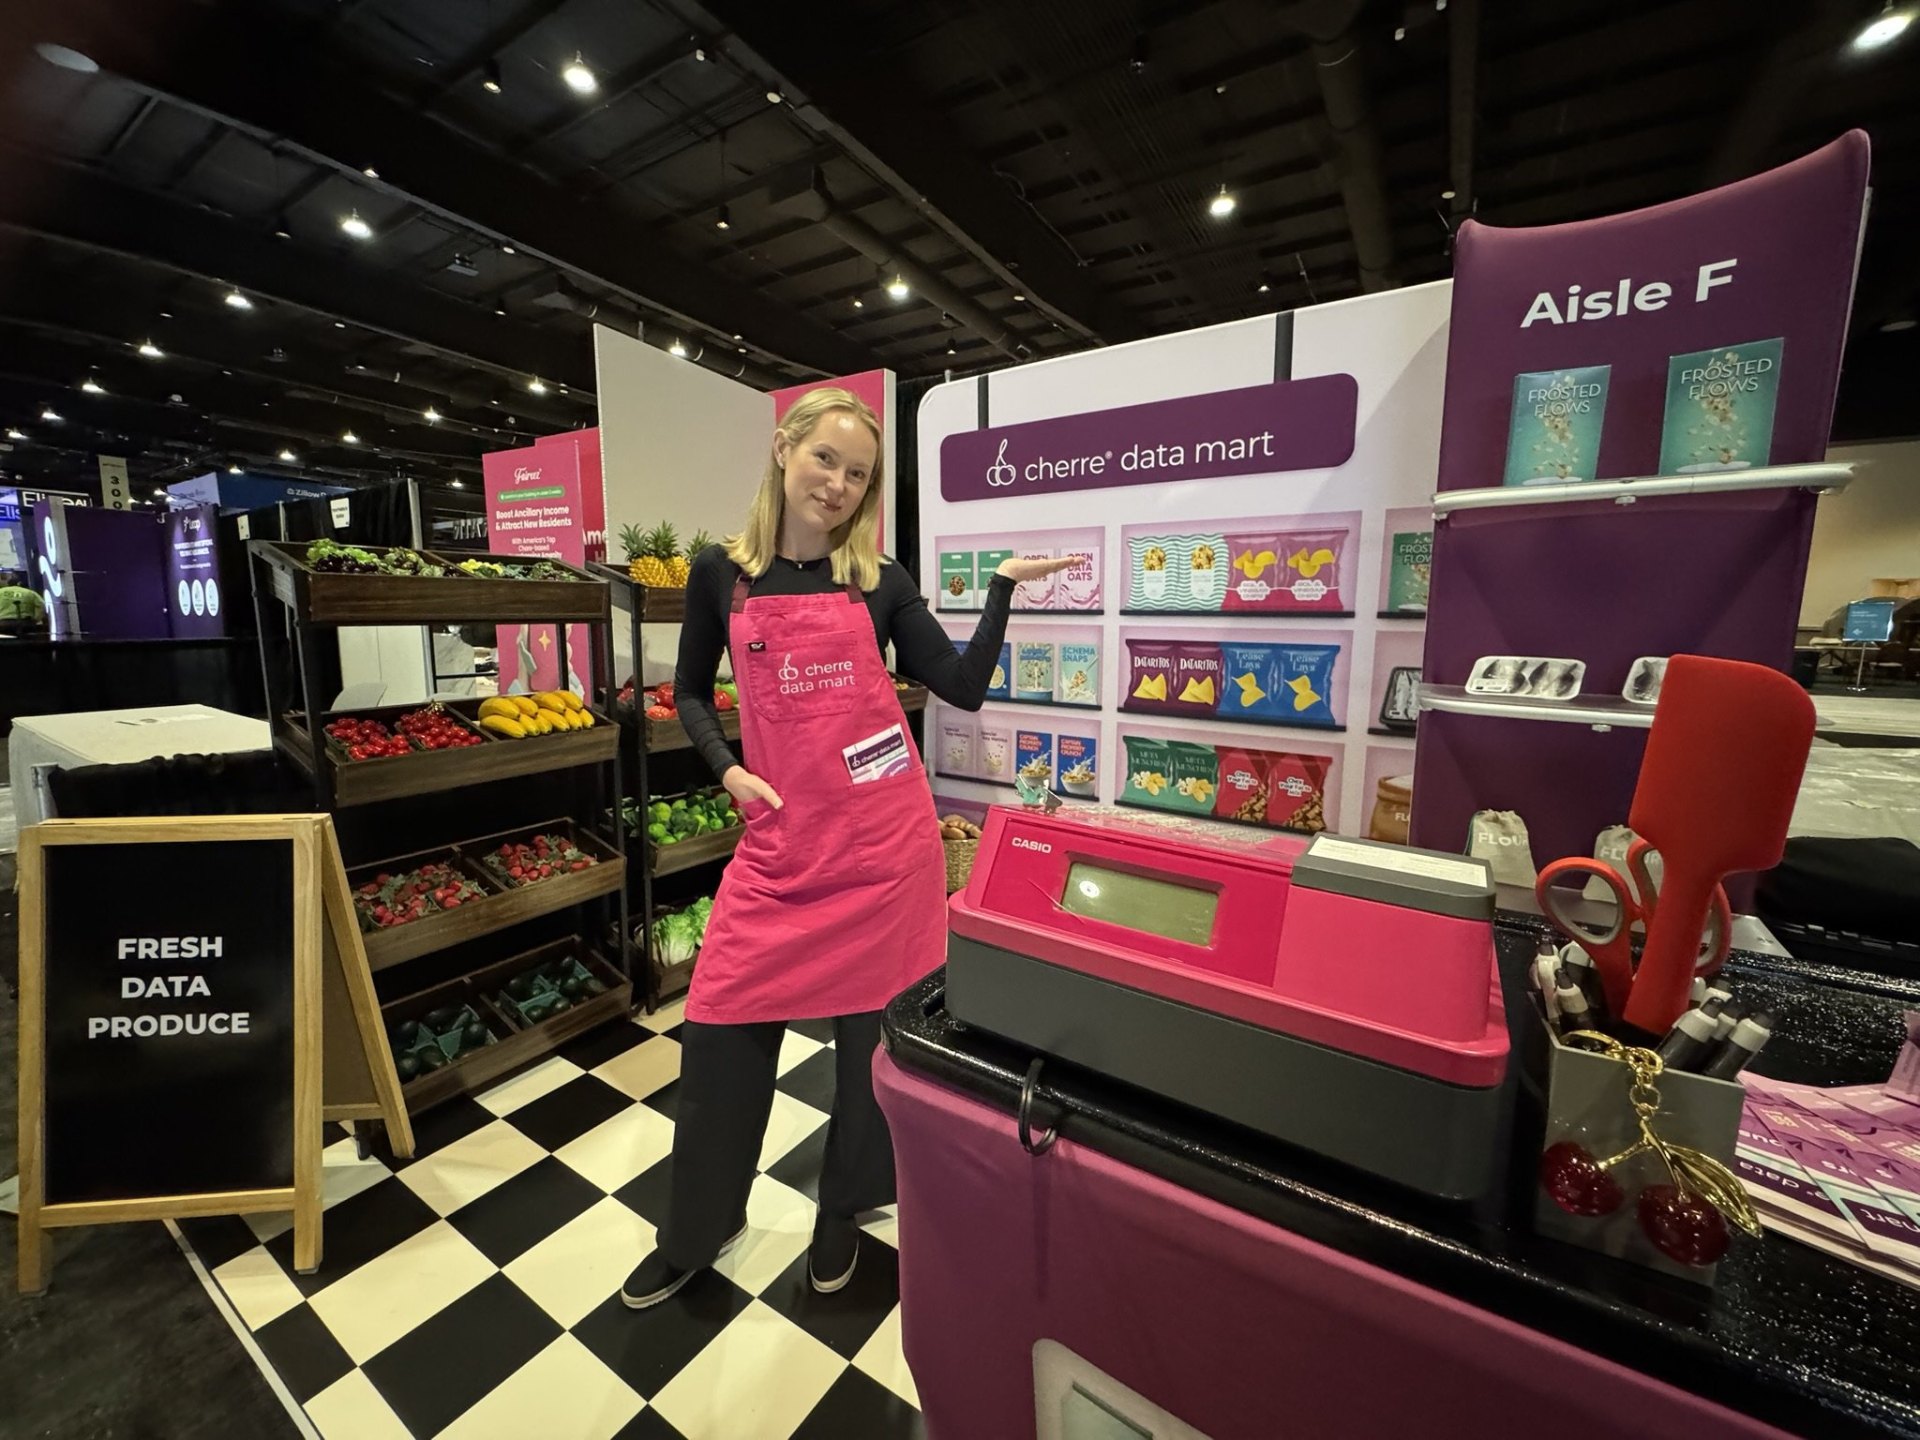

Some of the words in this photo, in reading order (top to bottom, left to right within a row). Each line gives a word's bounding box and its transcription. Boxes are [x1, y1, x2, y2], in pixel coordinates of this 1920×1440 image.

[1520, 278, 1672, 328] Aisle
[1696, 258, 1737, 302] F
[1680, 358, 1773, 384] FROSTED
[1528, 383, 1601, 403] FROSTED
[1688, 376, 1759, 401] FLOWS
[1534, 400, 1590, 418] FLOWS
[1120, 443, 1185, 471] data
[1195, 431, 1275, 463] mart
[496, 510, 514, 519] Boost
[514, 507, 543, 518] Ancillary
[543, 506, 569, 515] Income
[501, 520, 523, 530] Attract
[524, 520, 539, 528] New
[539, 518, 572, 528] Residents
[1067, 572, 1093, 581] OATS
[1062, 646, 1096, 655] SCHEMA
[1062, 654, 1088, 663] SNAPS
[805, 660, 853, 677] cherre
[1134, 656, 1170, 668] DATARITOS
[1180, 658, 1218, 671] DATARITOS
[779, 681, 815, 695] data
[818, 674, 856, 688] mart
[1011, 837, 1052, 854] CASIO
[118, 936, 223, 960] FRESH
[121, 975, 212, 999] DATA
[88, 1012, 250, 1039] PRODUCE
